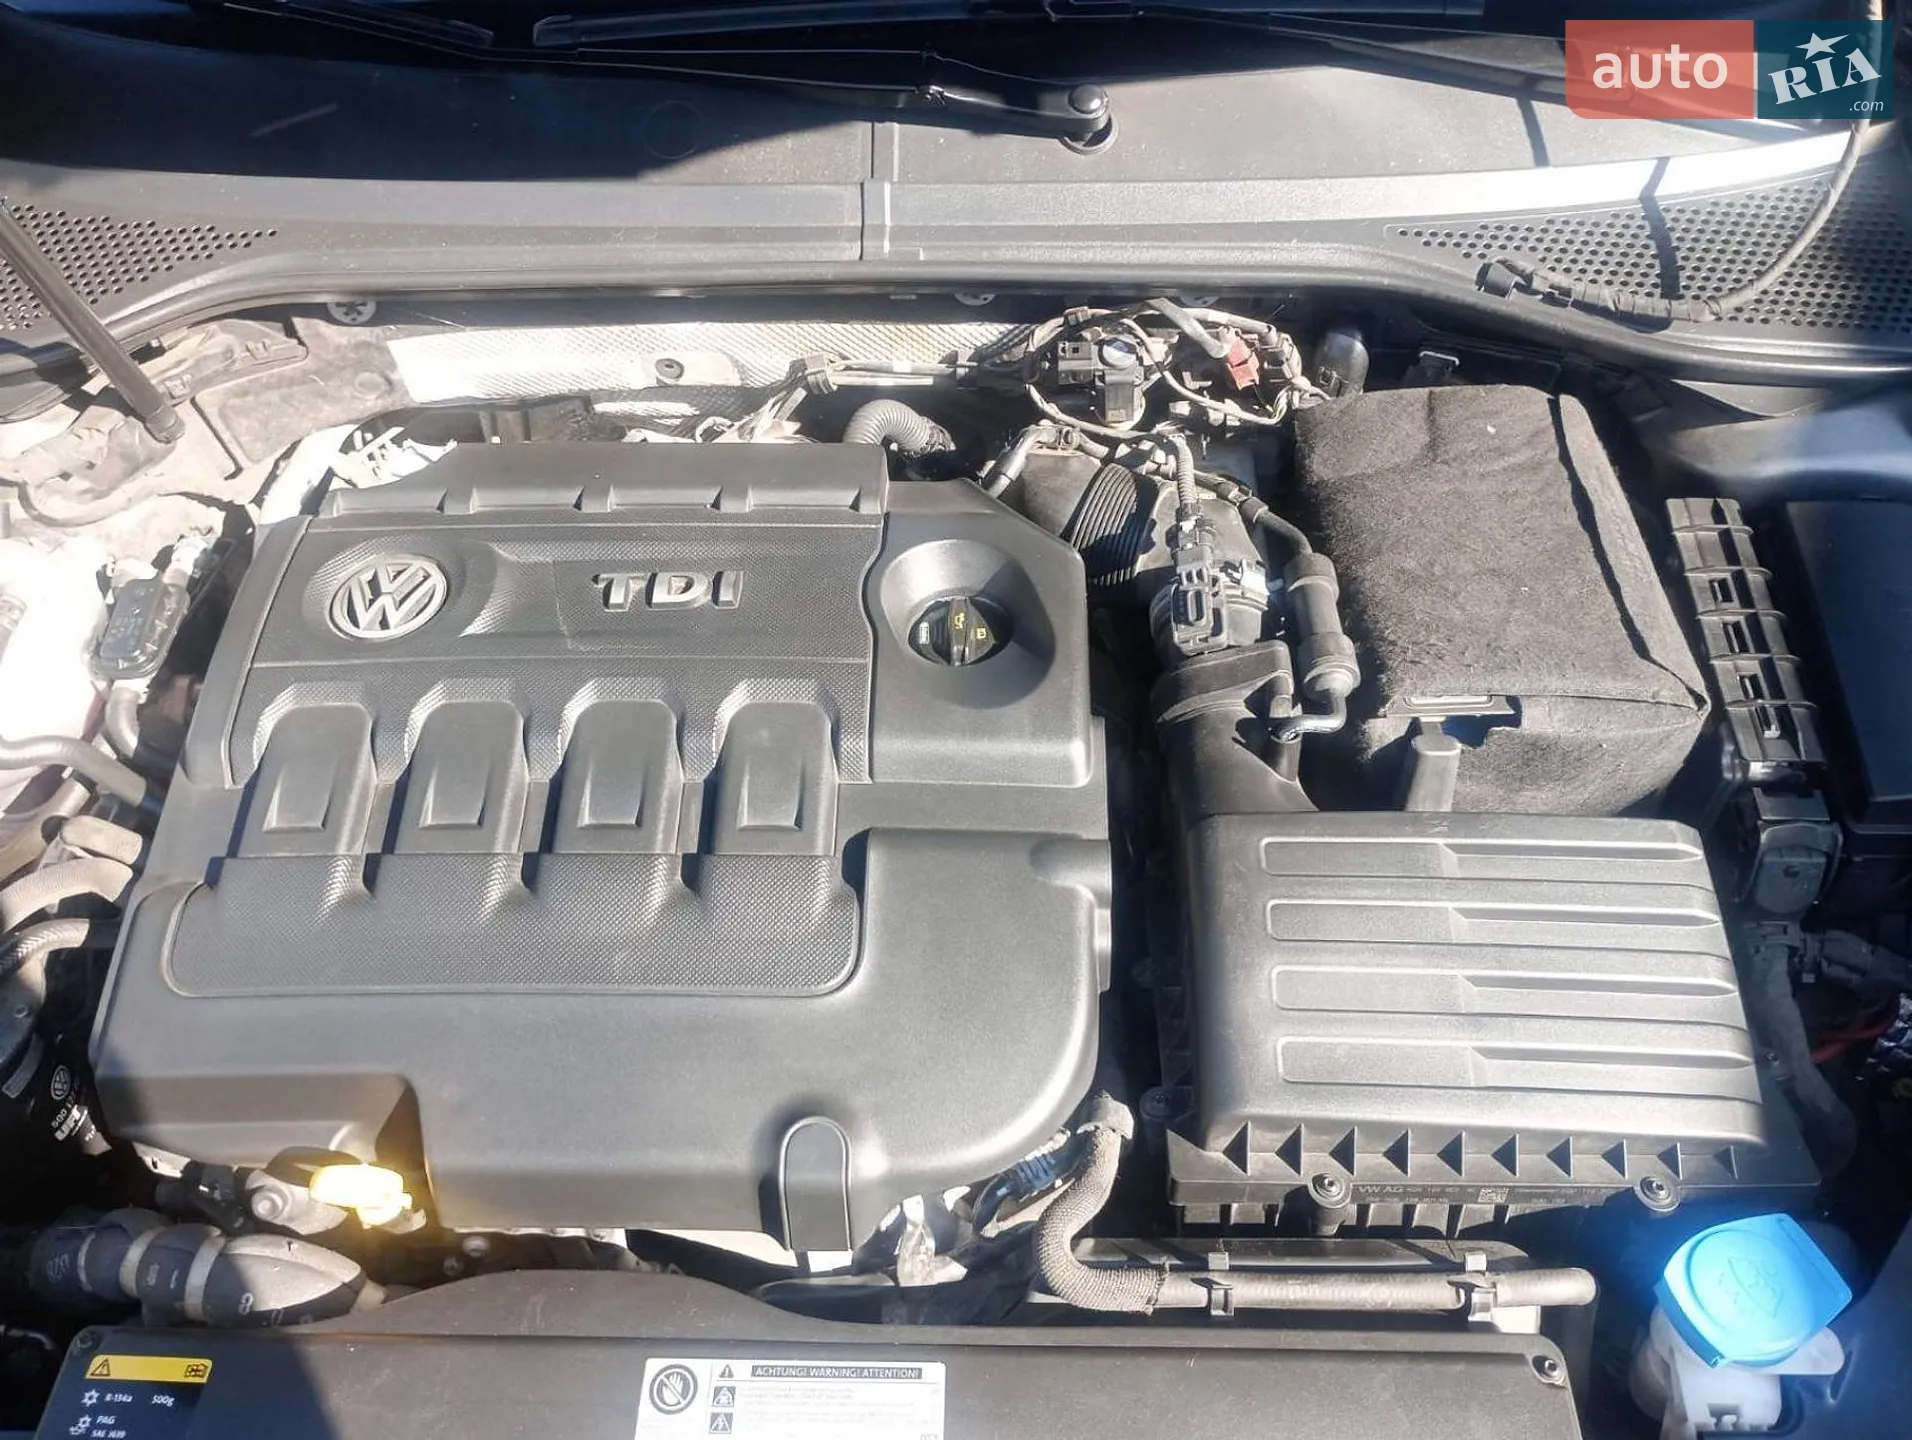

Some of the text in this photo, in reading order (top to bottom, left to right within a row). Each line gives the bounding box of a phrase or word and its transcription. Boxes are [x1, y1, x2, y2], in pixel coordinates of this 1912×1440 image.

[596, 569, 745, 612] TDI
[754, 1366, 920, 1379] ACHTUNG! WARNING! ATTENTION!
[151, 1394, 175, 1407] 500g
[96, 1415, 116, 1425] PAG
